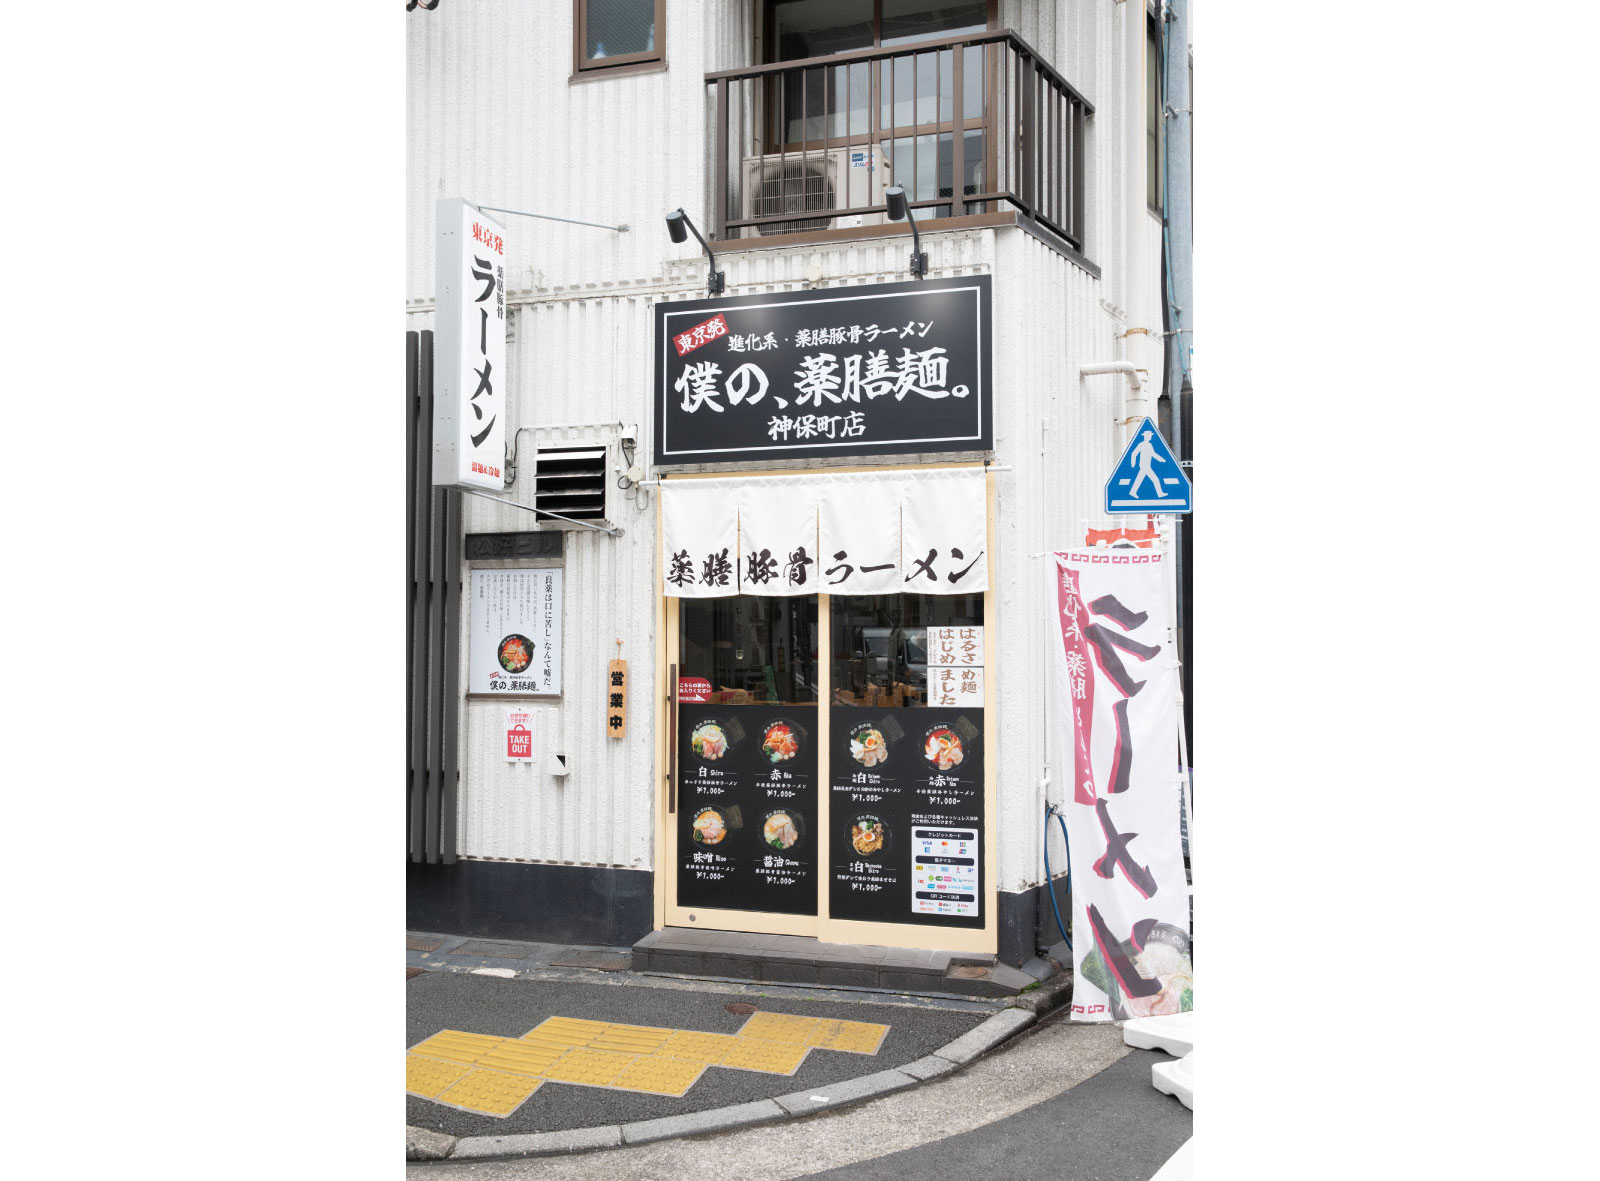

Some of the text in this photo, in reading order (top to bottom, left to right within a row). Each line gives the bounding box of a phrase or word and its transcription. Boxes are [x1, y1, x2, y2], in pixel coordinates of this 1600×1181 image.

[472, 221, 503, 255] 東京発
[678, 317, 727, 354] 東京発
[470, 253, 497, 448] ラーメン
[674, 346, 970, 413] 僕の、薬膳麺。
[767, 410, 866, 441] 神保町店
[609, 671, 625, 730] 営業中
[509, 735, 529, 744] TAKE
[512, 744, 528, 753] OUT
[698, 766, 708, 777] 白
[770, 769, 781, 780] 赤
[857, 772, 867, 784] 白
[934, 774, 946, 787] 赤
[763, 855, 784, 868] 醤油
[854, 861, 864, 873] 白
